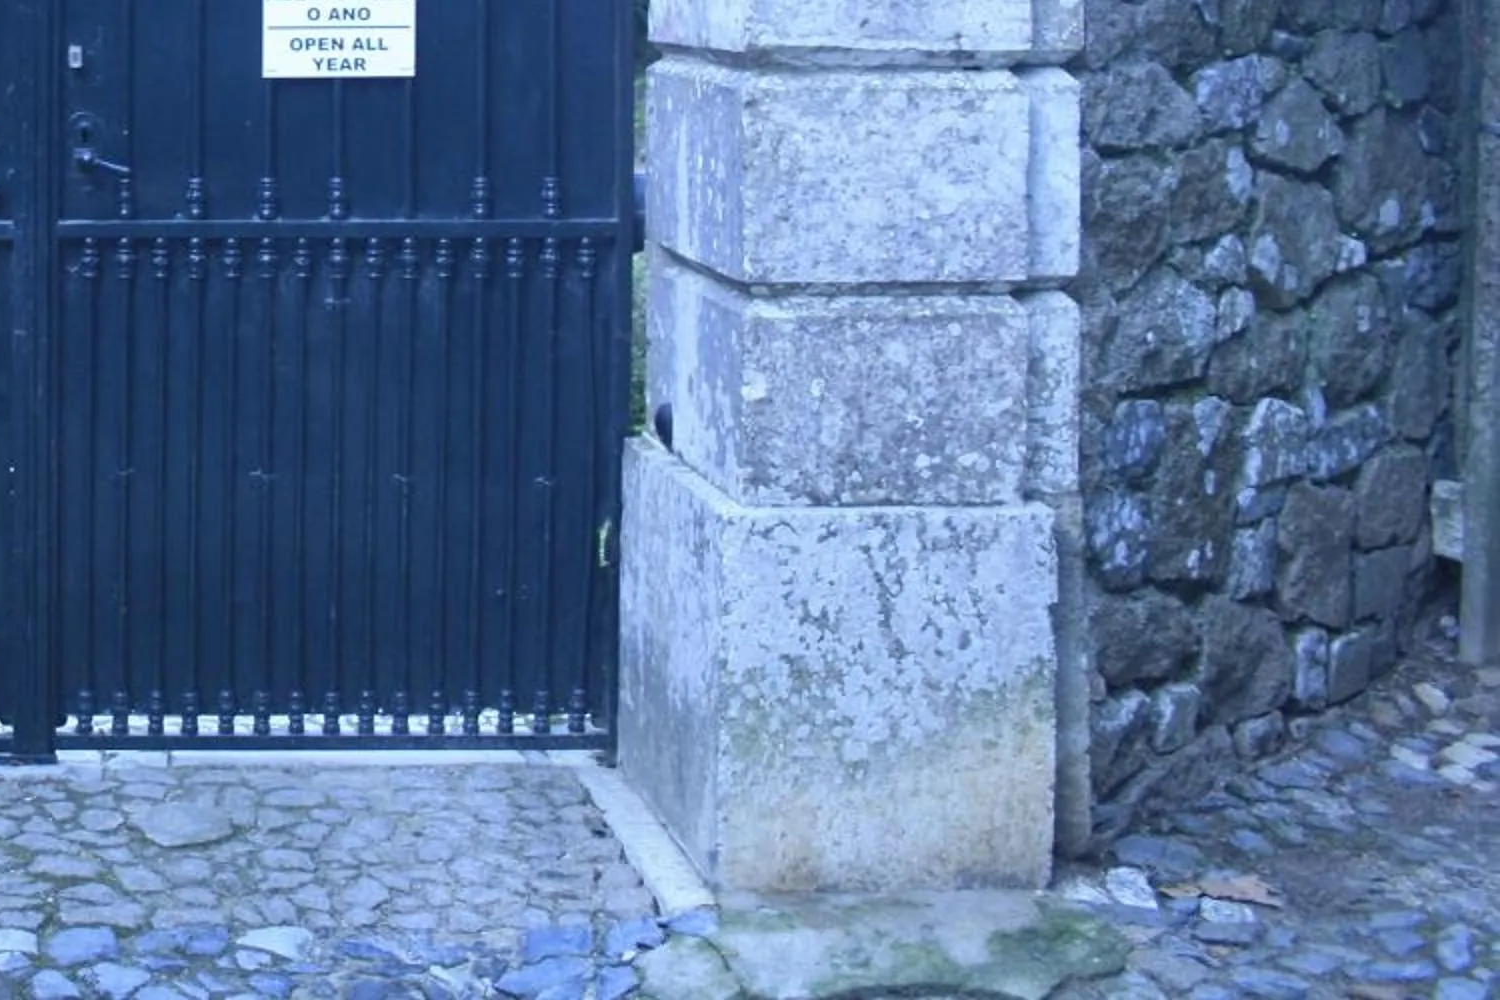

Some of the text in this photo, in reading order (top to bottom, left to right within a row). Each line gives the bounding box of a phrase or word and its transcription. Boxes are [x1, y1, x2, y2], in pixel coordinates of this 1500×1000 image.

[307, 7, 371, 21] O ANO
[289, 37, 389, 51] OPEN ALL
[313, 57, 367, 71] YEAR
